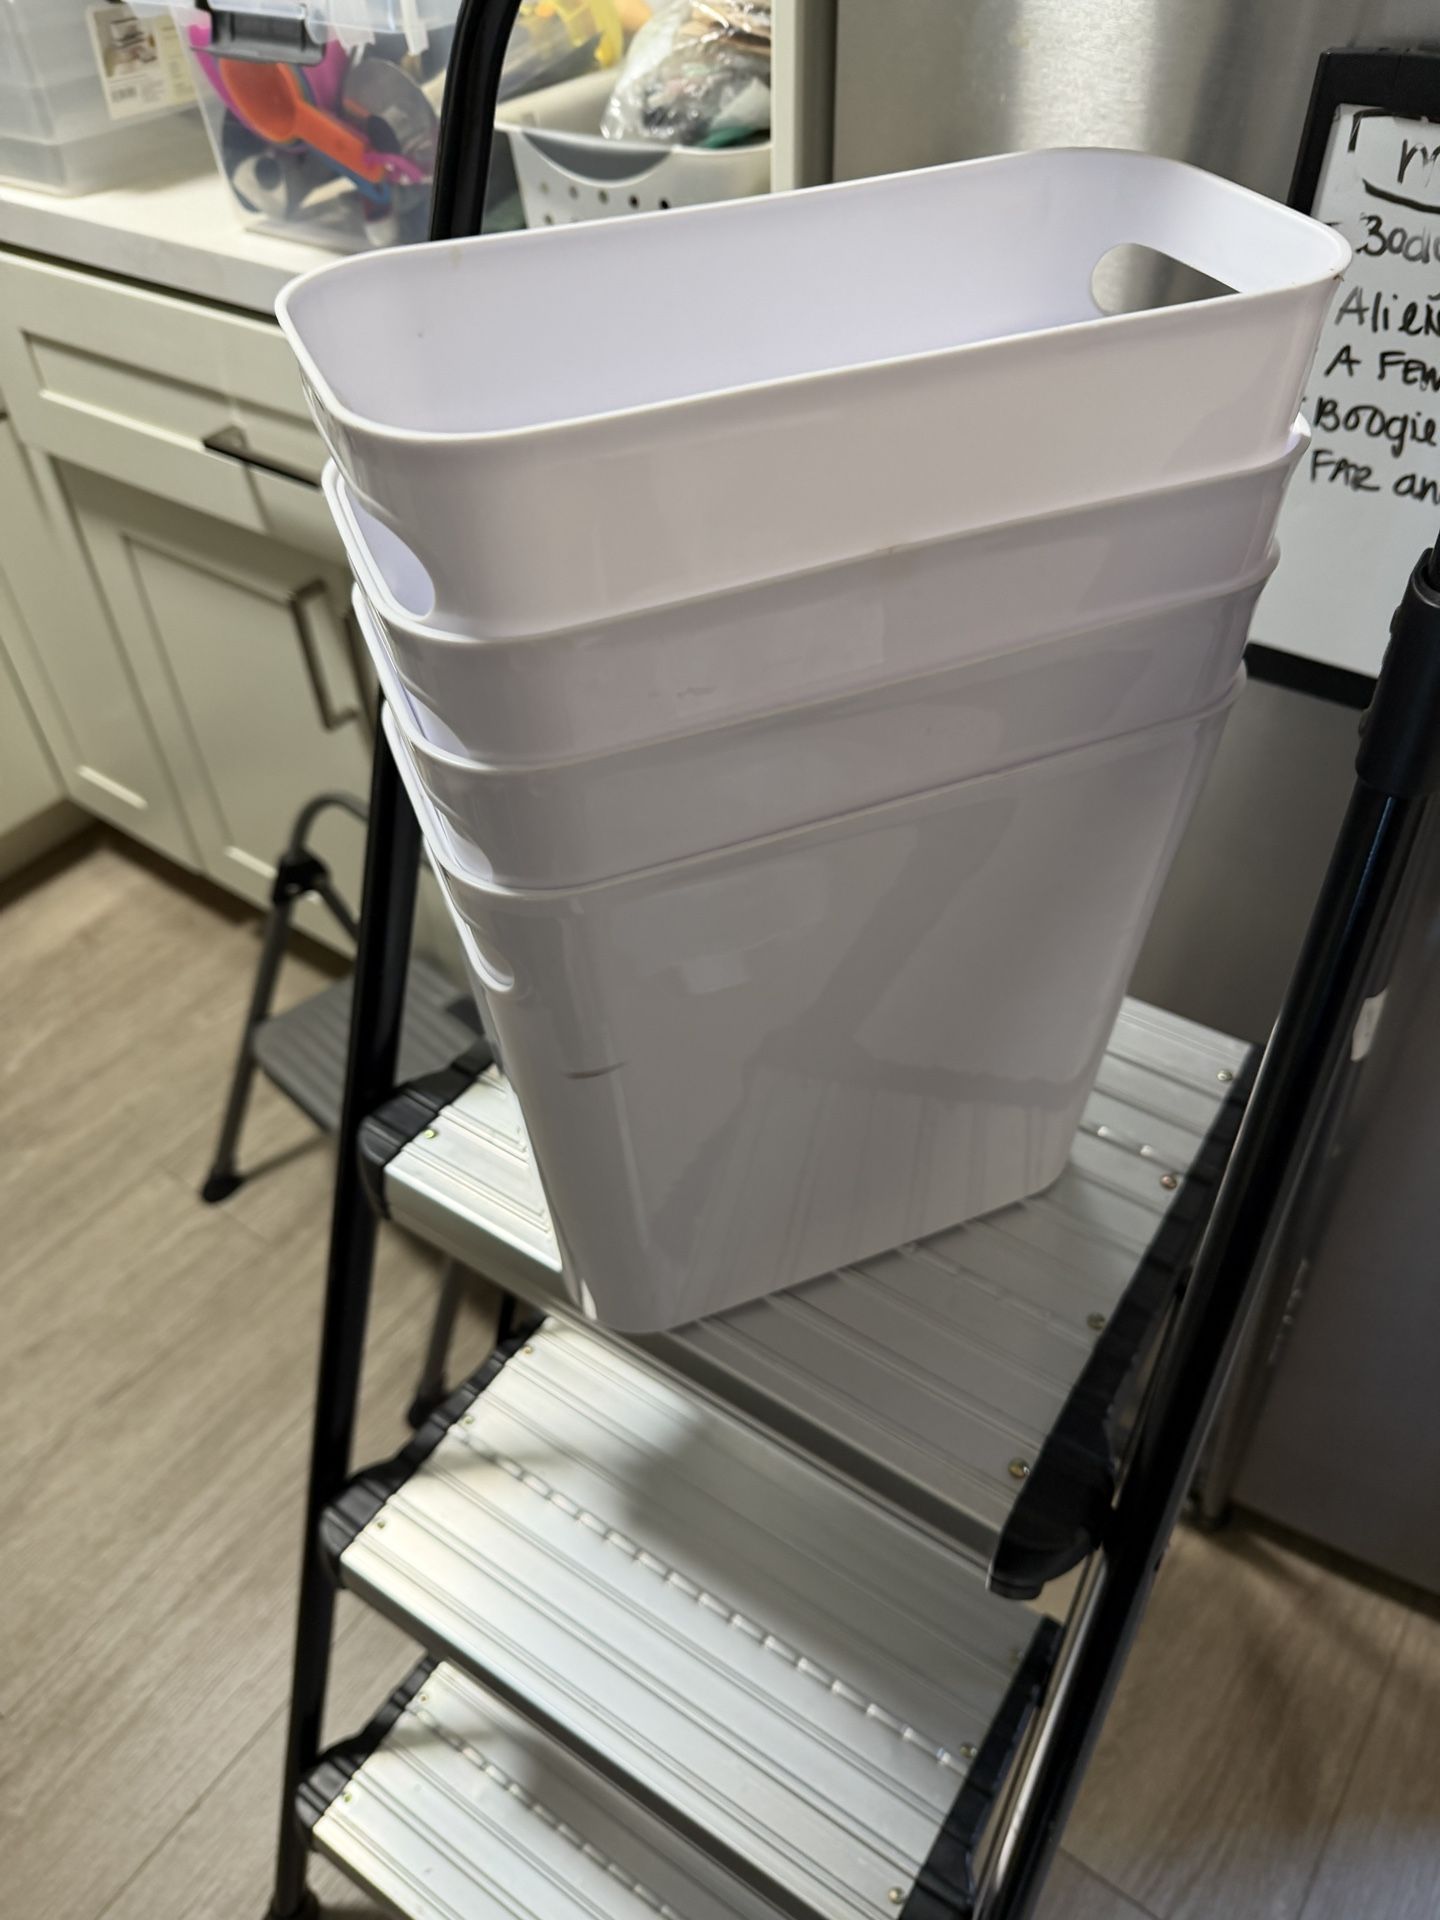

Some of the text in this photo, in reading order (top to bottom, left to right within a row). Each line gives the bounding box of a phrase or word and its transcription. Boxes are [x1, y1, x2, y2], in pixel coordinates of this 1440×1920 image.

[1324, 345, 1361, 377] A
[1311, 450, 1440, 505] FAR an
